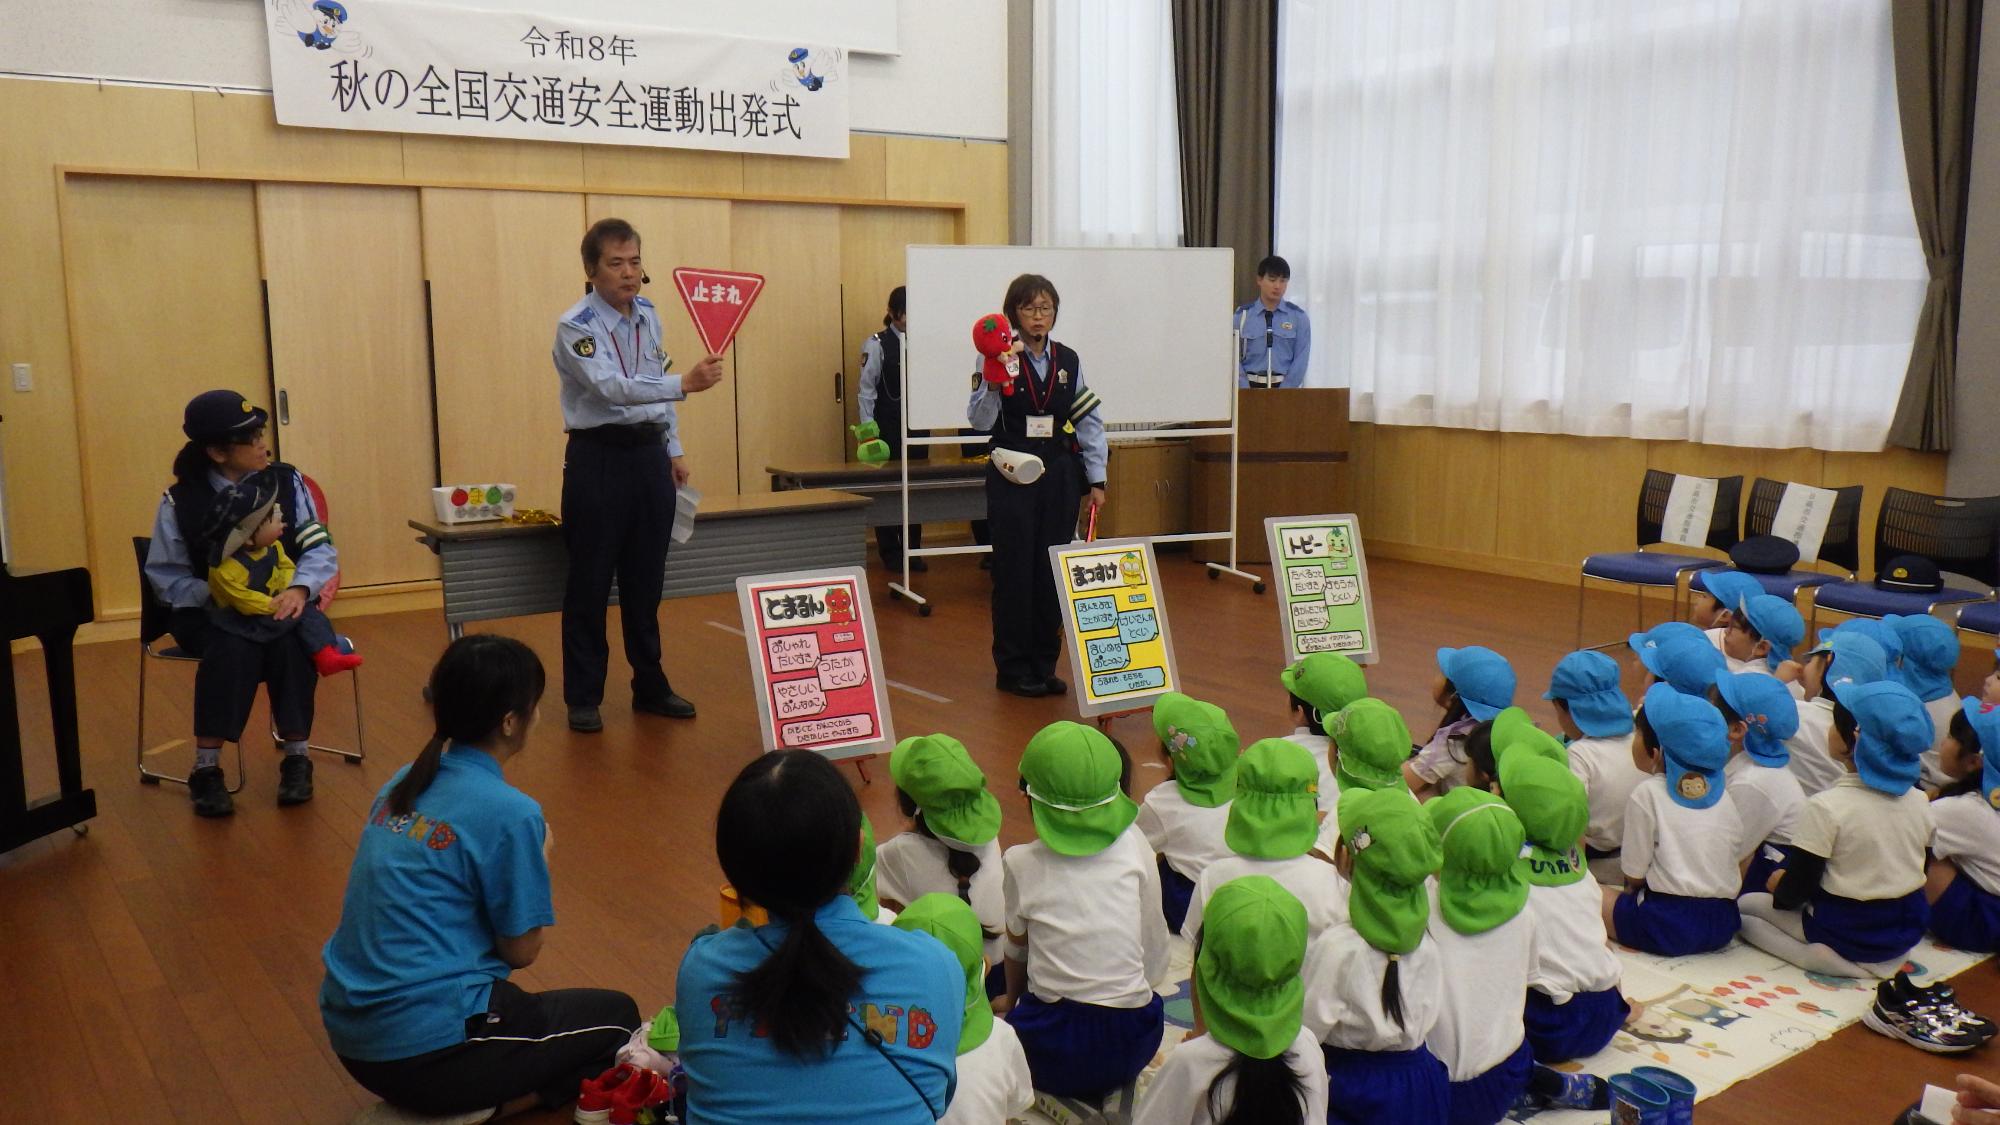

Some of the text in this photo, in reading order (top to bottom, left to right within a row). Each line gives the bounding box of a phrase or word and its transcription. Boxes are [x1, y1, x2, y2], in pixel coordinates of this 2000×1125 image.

[520, 25, 638, 67] 令和8年
[329, 59, 802, 140] 秋の全国交通安全運動出発式
[691, 280, 743, 306] 止まれ
[1295, 581, 1321, 592] だいすき
[1331, 592, 1351, 603] とくい
[765, 594, 825, 620] とまるん
[1129, 628, 1150, 639] とくい
[772, 637, 811, 654] おしゃれ
[1090, 643, 1122, 656] まじめな
[778, 653, 813, 669] だいすき
[820, 656, 854, 672] うたが
[831, 671, 857, 686] とくい
[777, 683, 818, 698] やさしい
[782, 696, 821, 713] おんなのこ
